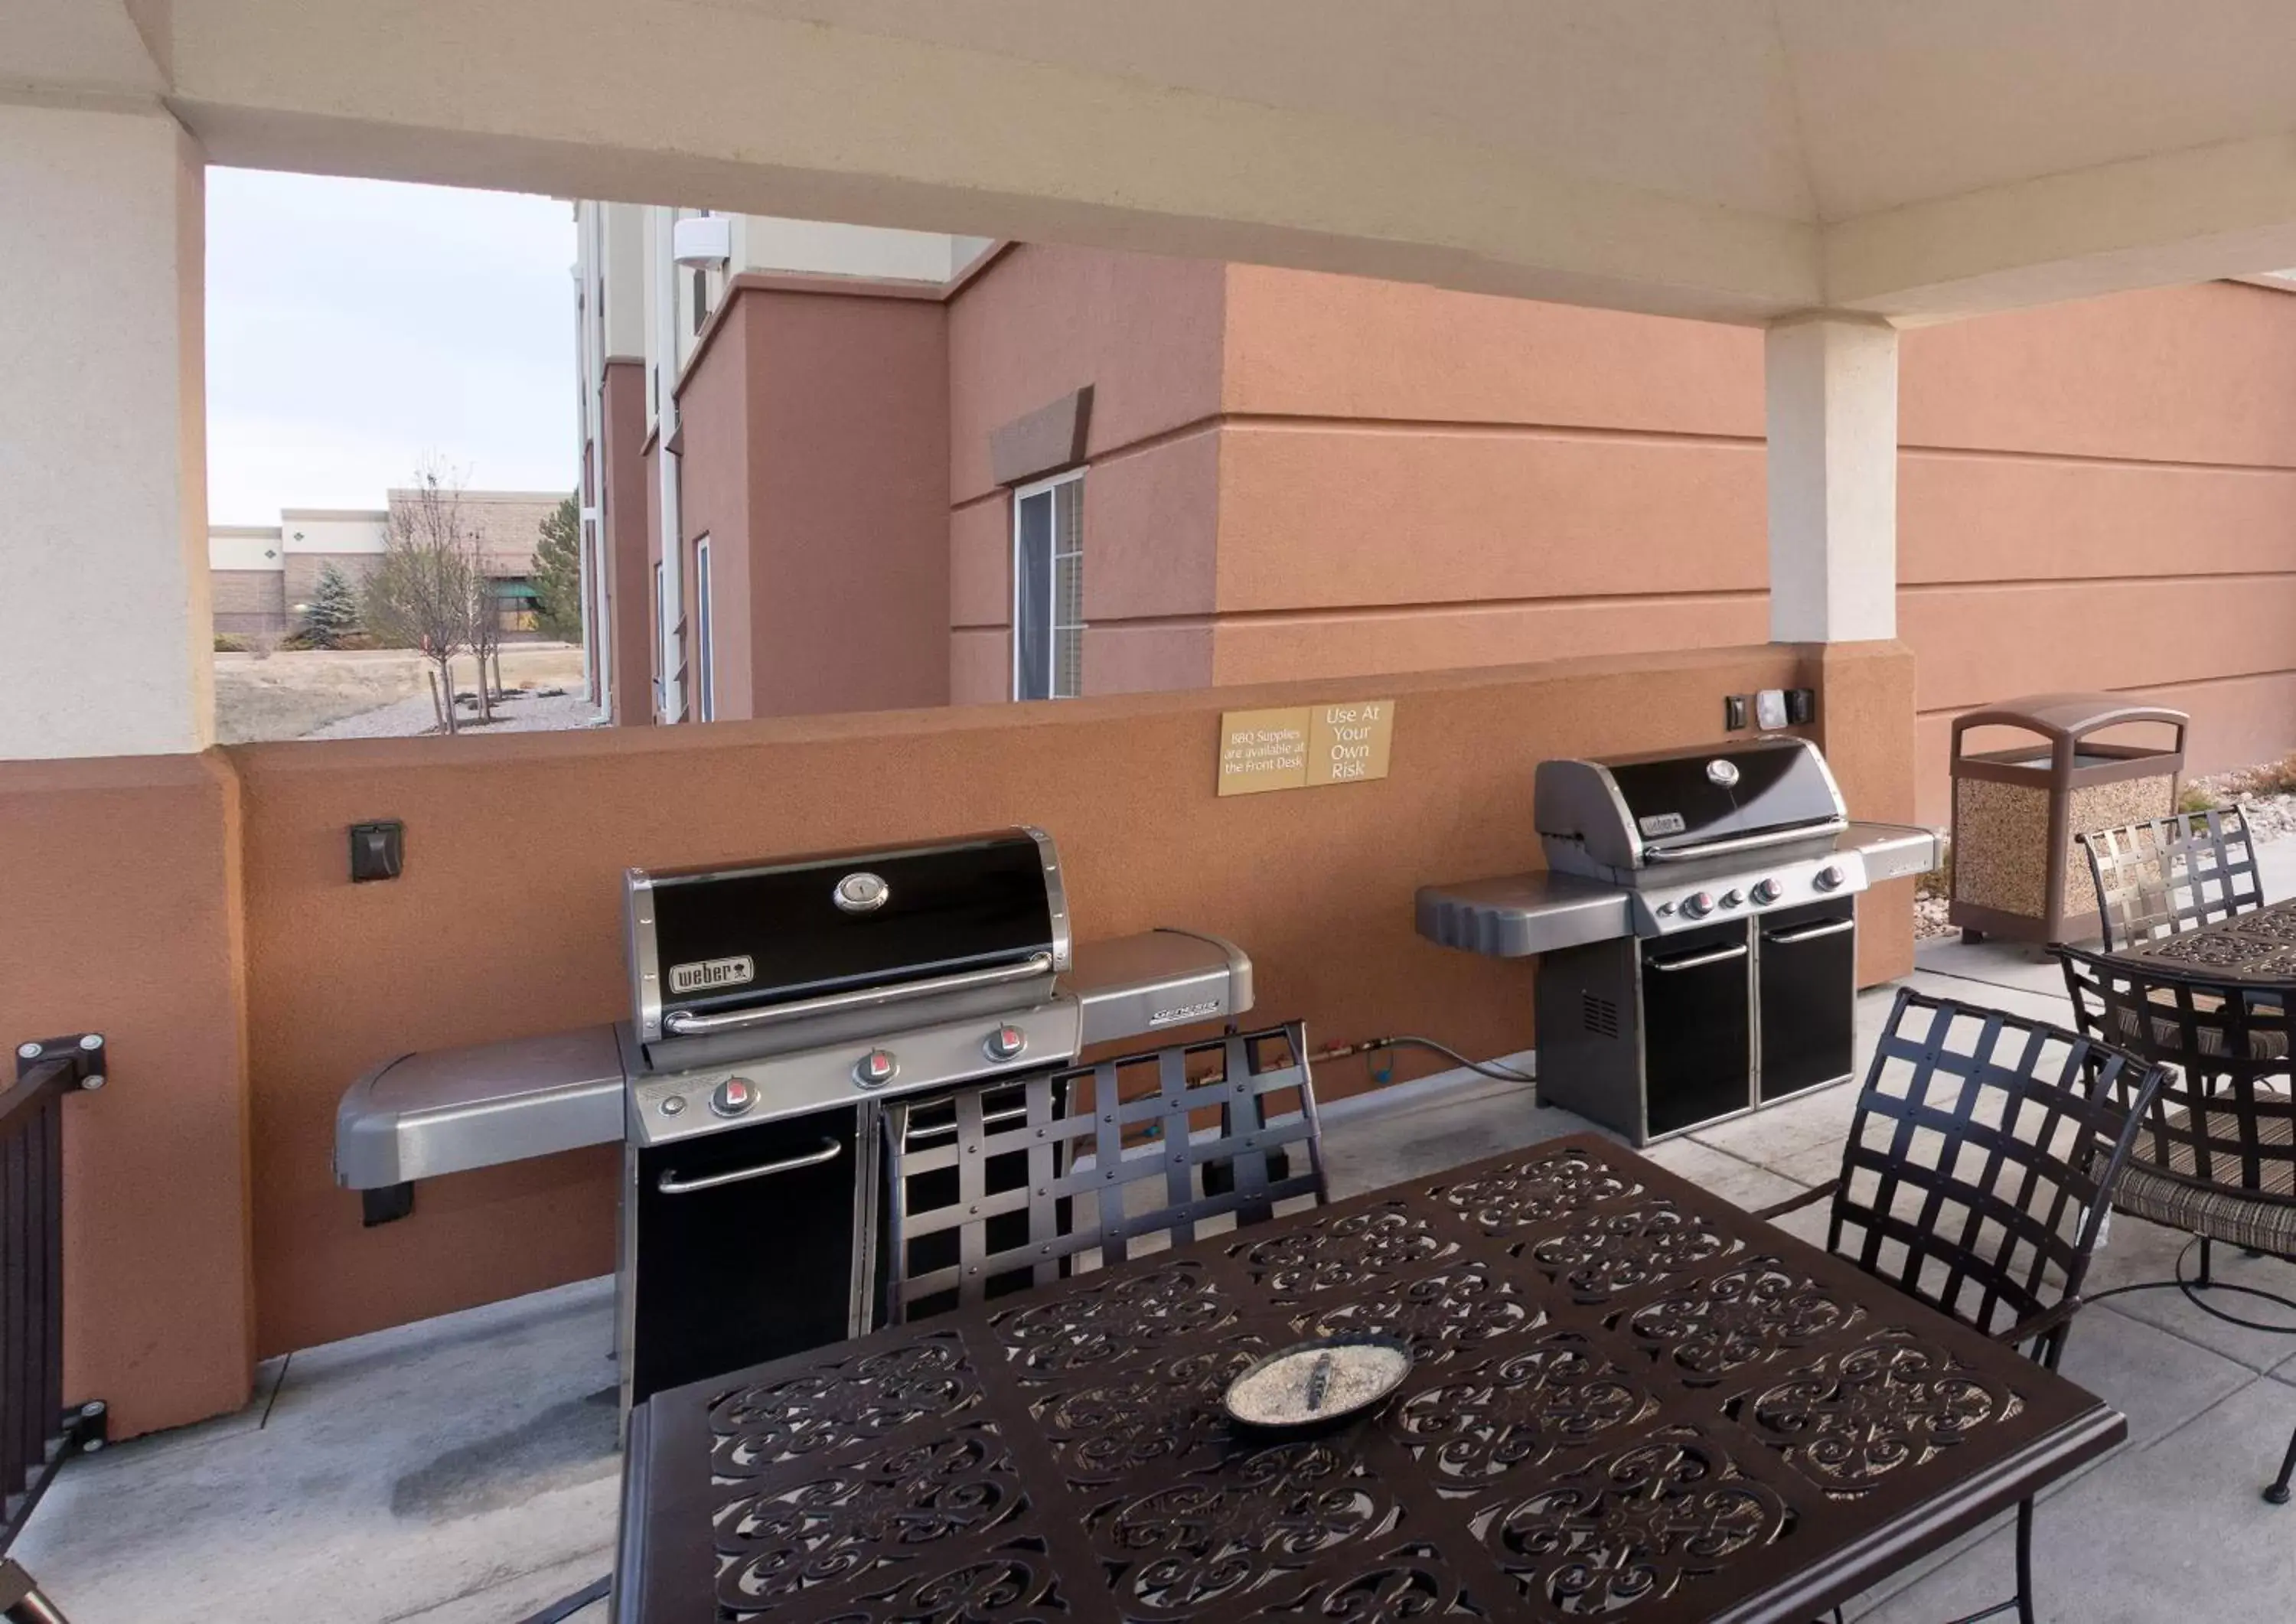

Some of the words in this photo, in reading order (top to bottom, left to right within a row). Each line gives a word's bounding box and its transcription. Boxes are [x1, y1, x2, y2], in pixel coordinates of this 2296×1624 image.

[1327, 707, 1357, 723] Use
[1362, 705, 1380, 721] At
[1231, 732, 1254, 745] BBQ
[1257, 729, 1300, 743] Supplies
[1332, 726, 1371, 742] Your
[1225, 748, 1243, 760] are
[1245, 743, 1292, 758] available
[1294, 742, 1304, 753] at
[1331, 745, 1369, 760] Own
[1225, 761, 1243, 774] the
[1245, 758, 1274, 773] Front
[1277, 755, 1303, 770] Desk
[1332, 760, 1365, 778] Risk
[678, 963, 731, 986] weber
